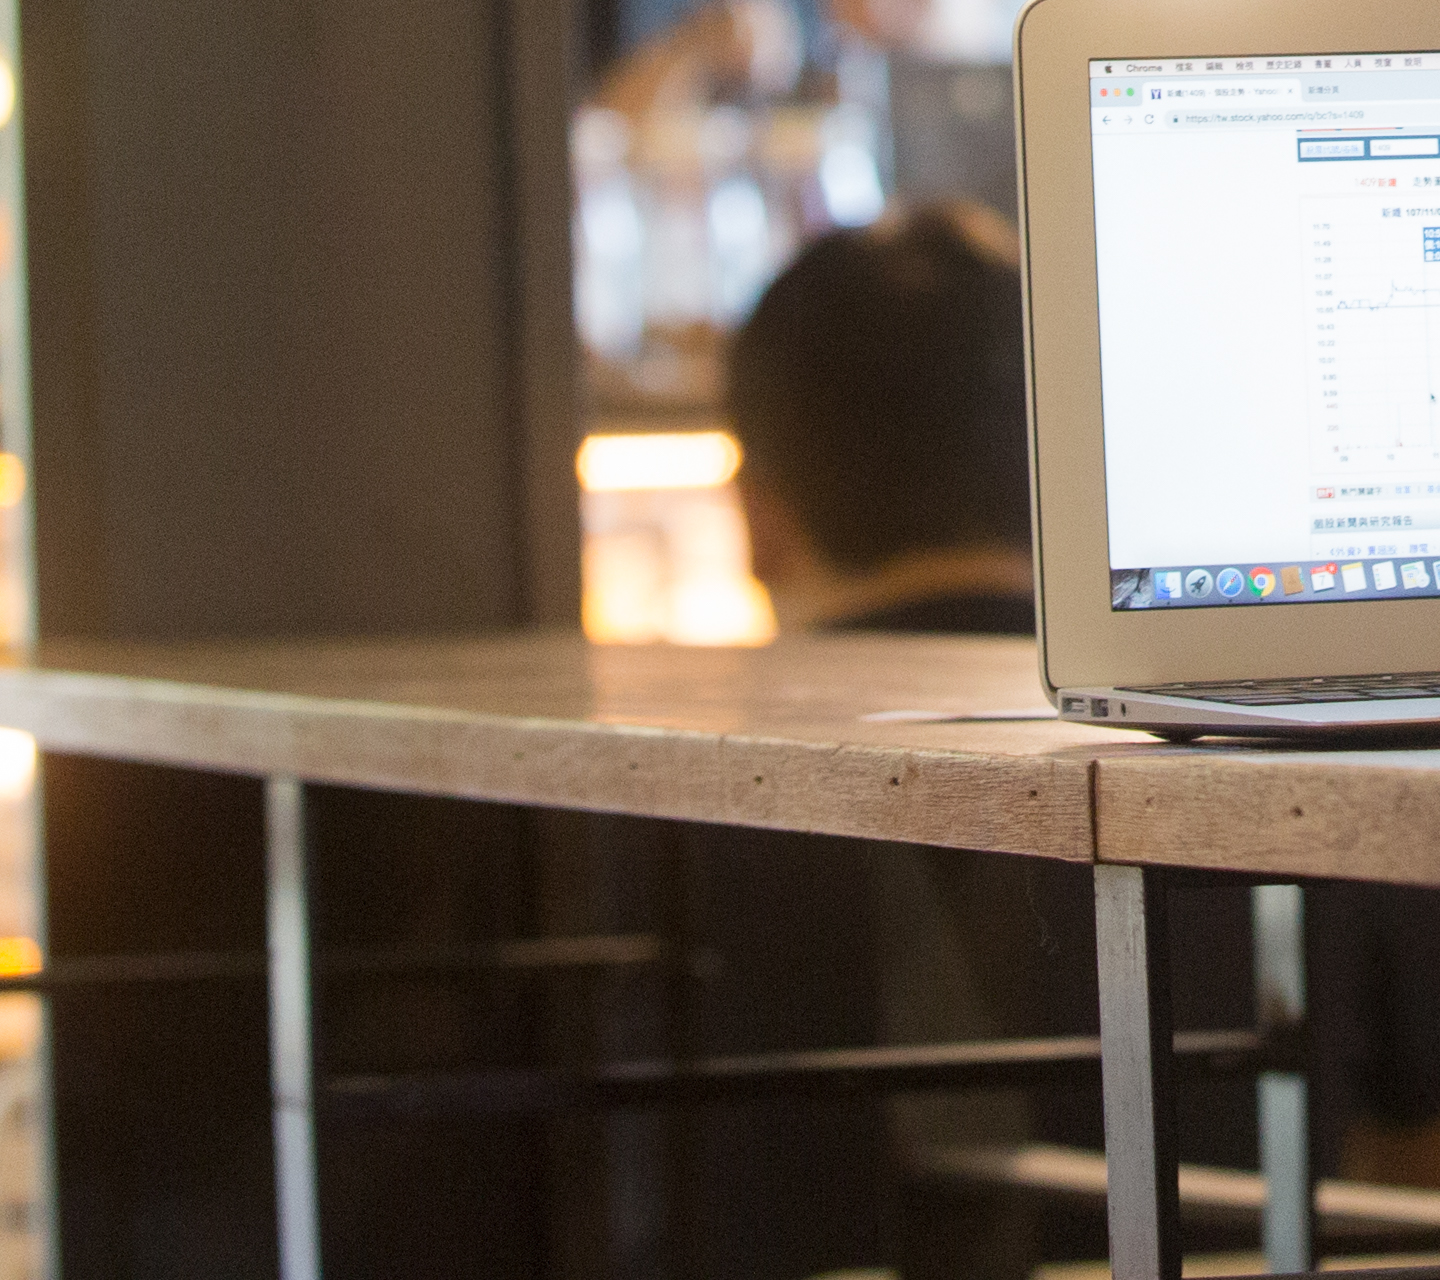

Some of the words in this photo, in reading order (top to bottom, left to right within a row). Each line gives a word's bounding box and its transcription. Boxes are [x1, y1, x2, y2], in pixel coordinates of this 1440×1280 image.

[1126, 64, 1162, 72] Chrome
[1206, 61, 1223, 71] 編輯
[1345, 59, 1361, 68] 人員
